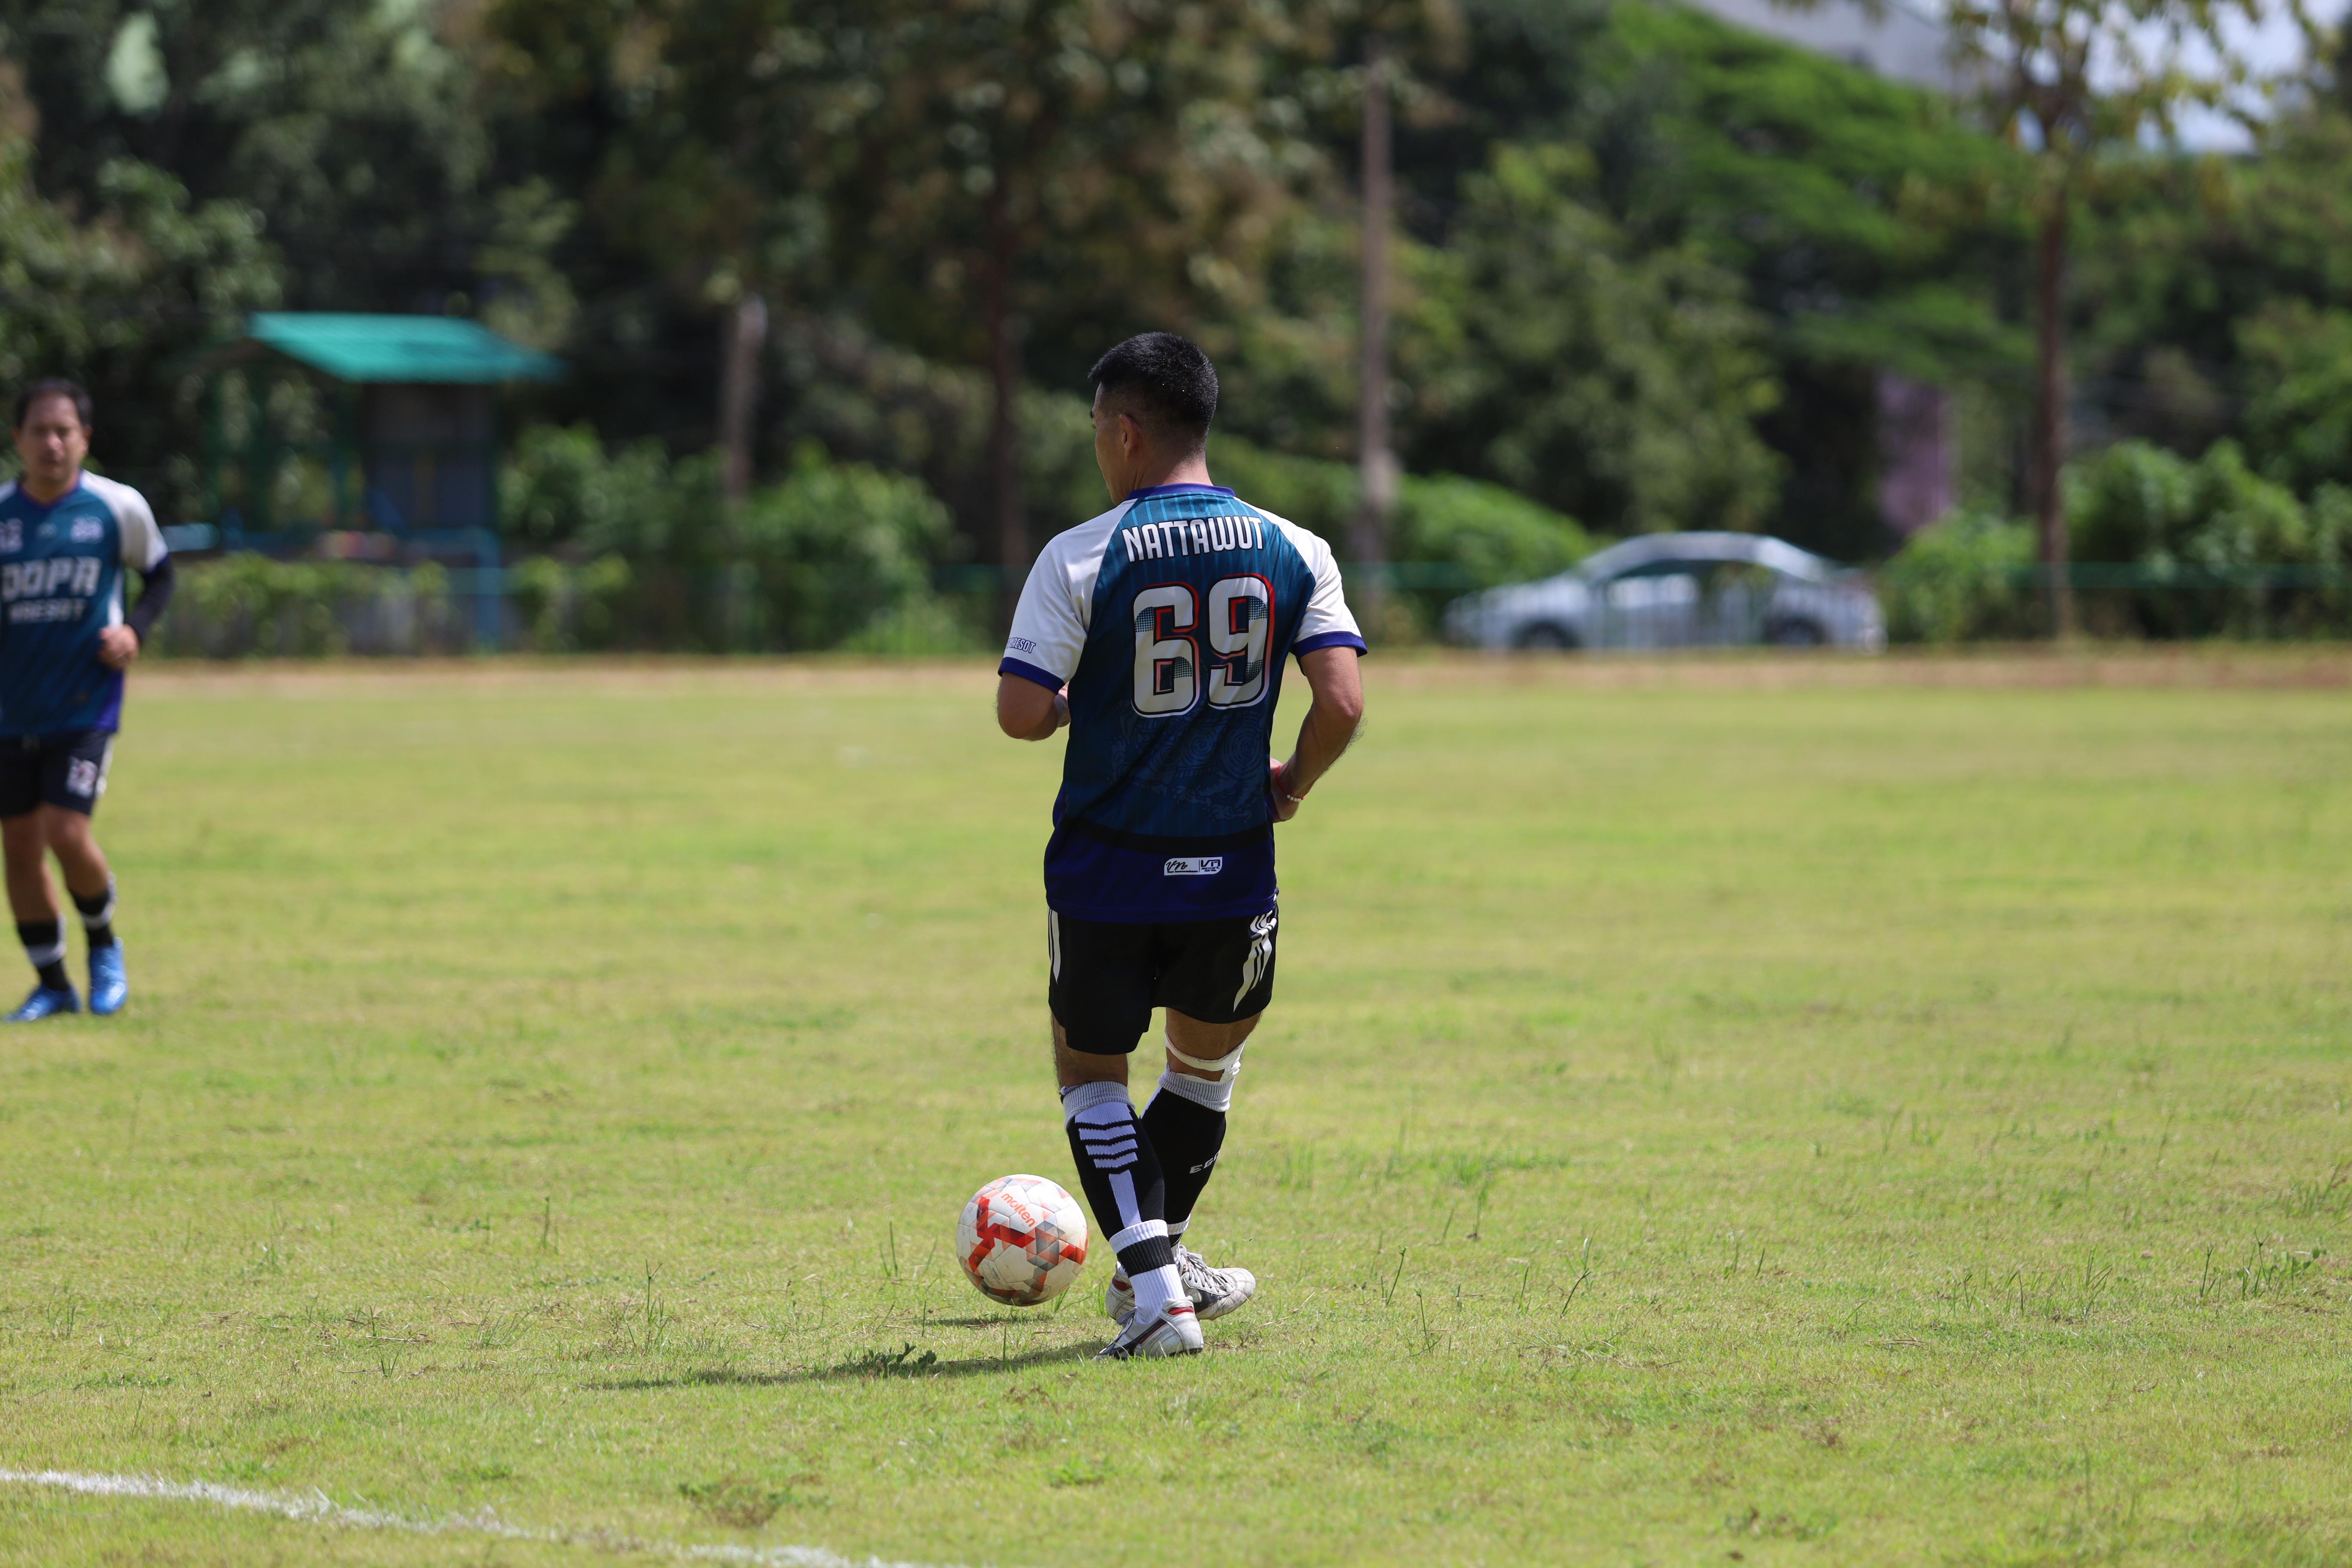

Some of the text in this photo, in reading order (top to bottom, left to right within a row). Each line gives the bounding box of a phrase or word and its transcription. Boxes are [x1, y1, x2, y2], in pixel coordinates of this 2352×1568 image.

[1121, 515, 1264, 563] NATTAWUT
[1131, 573, 1276, 718] 69
[1001, 1193, 1035, 1227] molten
